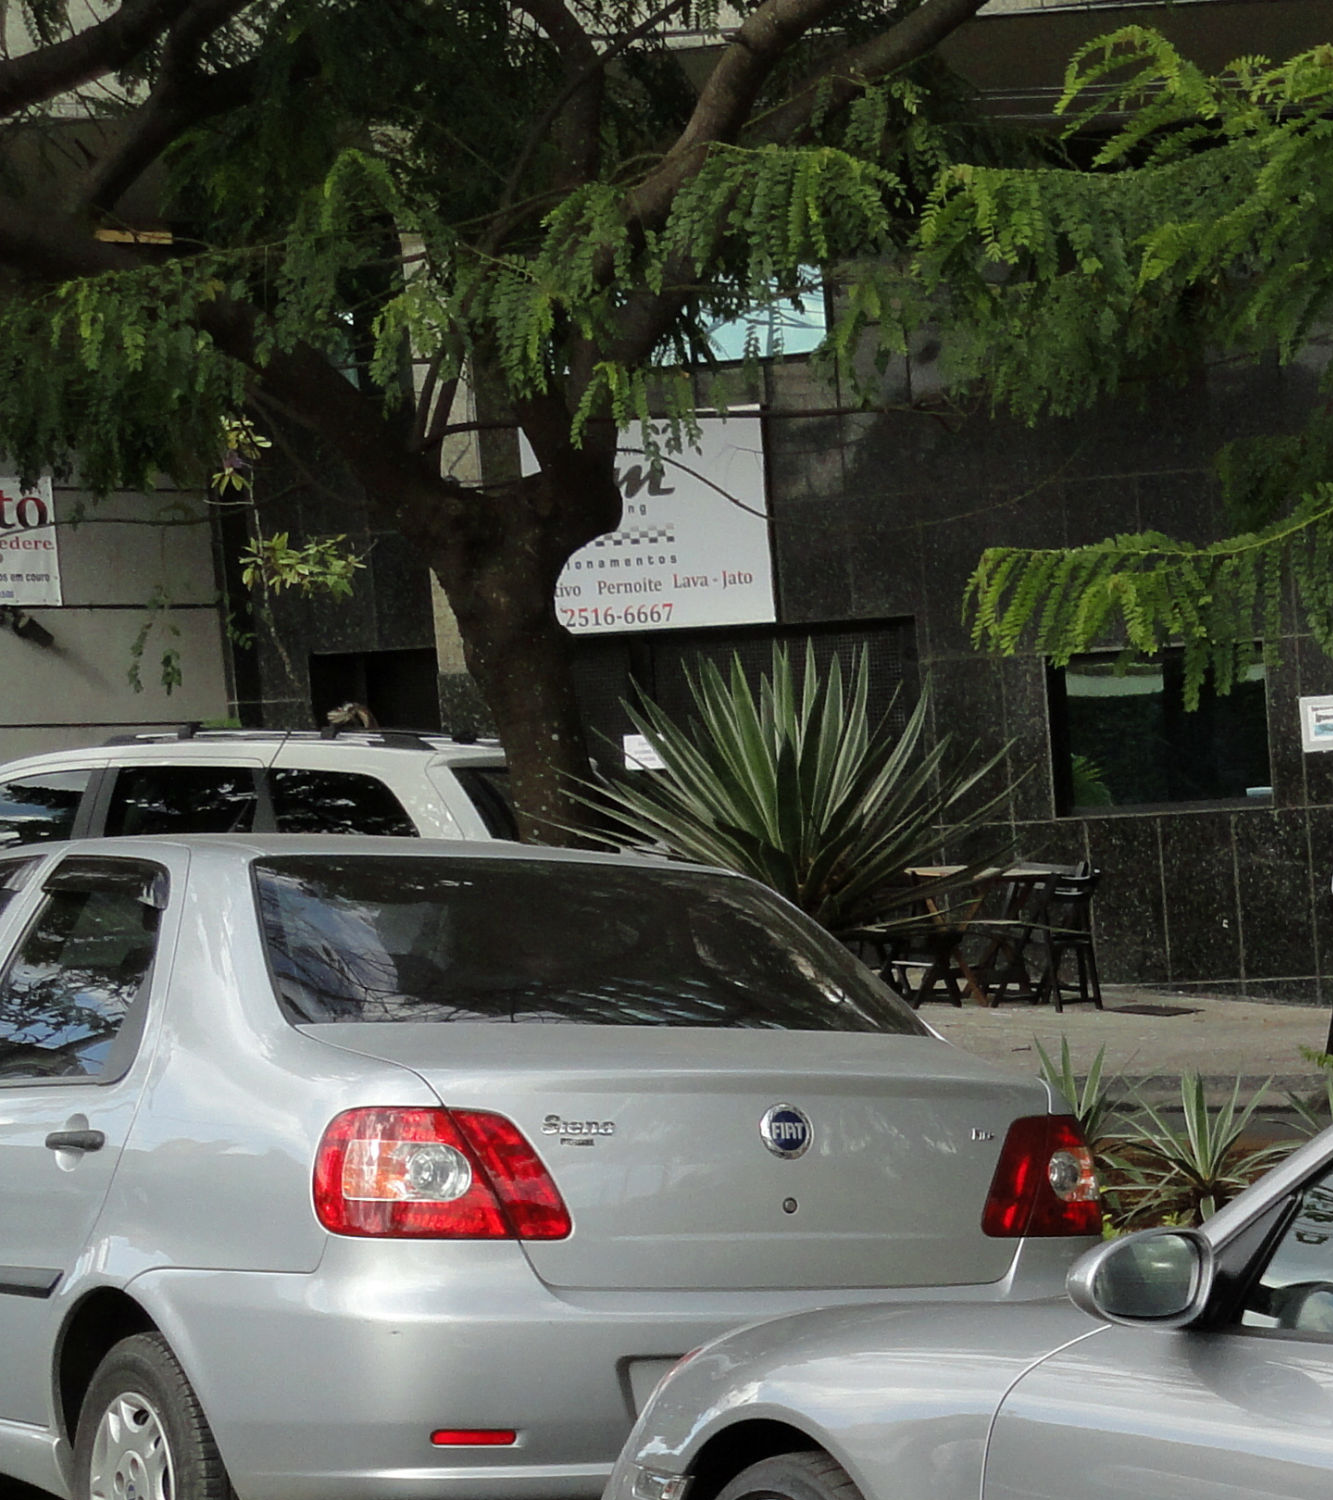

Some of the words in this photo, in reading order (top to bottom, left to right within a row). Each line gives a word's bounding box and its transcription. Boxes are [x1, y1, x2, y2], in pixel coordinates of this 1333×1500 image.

[597, 580, 663, 596] Pernoite
[673, 572, 709, 589] Lava
[722, 570, 754, 590] Jato
[565, 602, 675, 629] 2516-6667
[541, 1114, 617, 1136] Siena
[771, 1122, 804, 1140] FIAT
